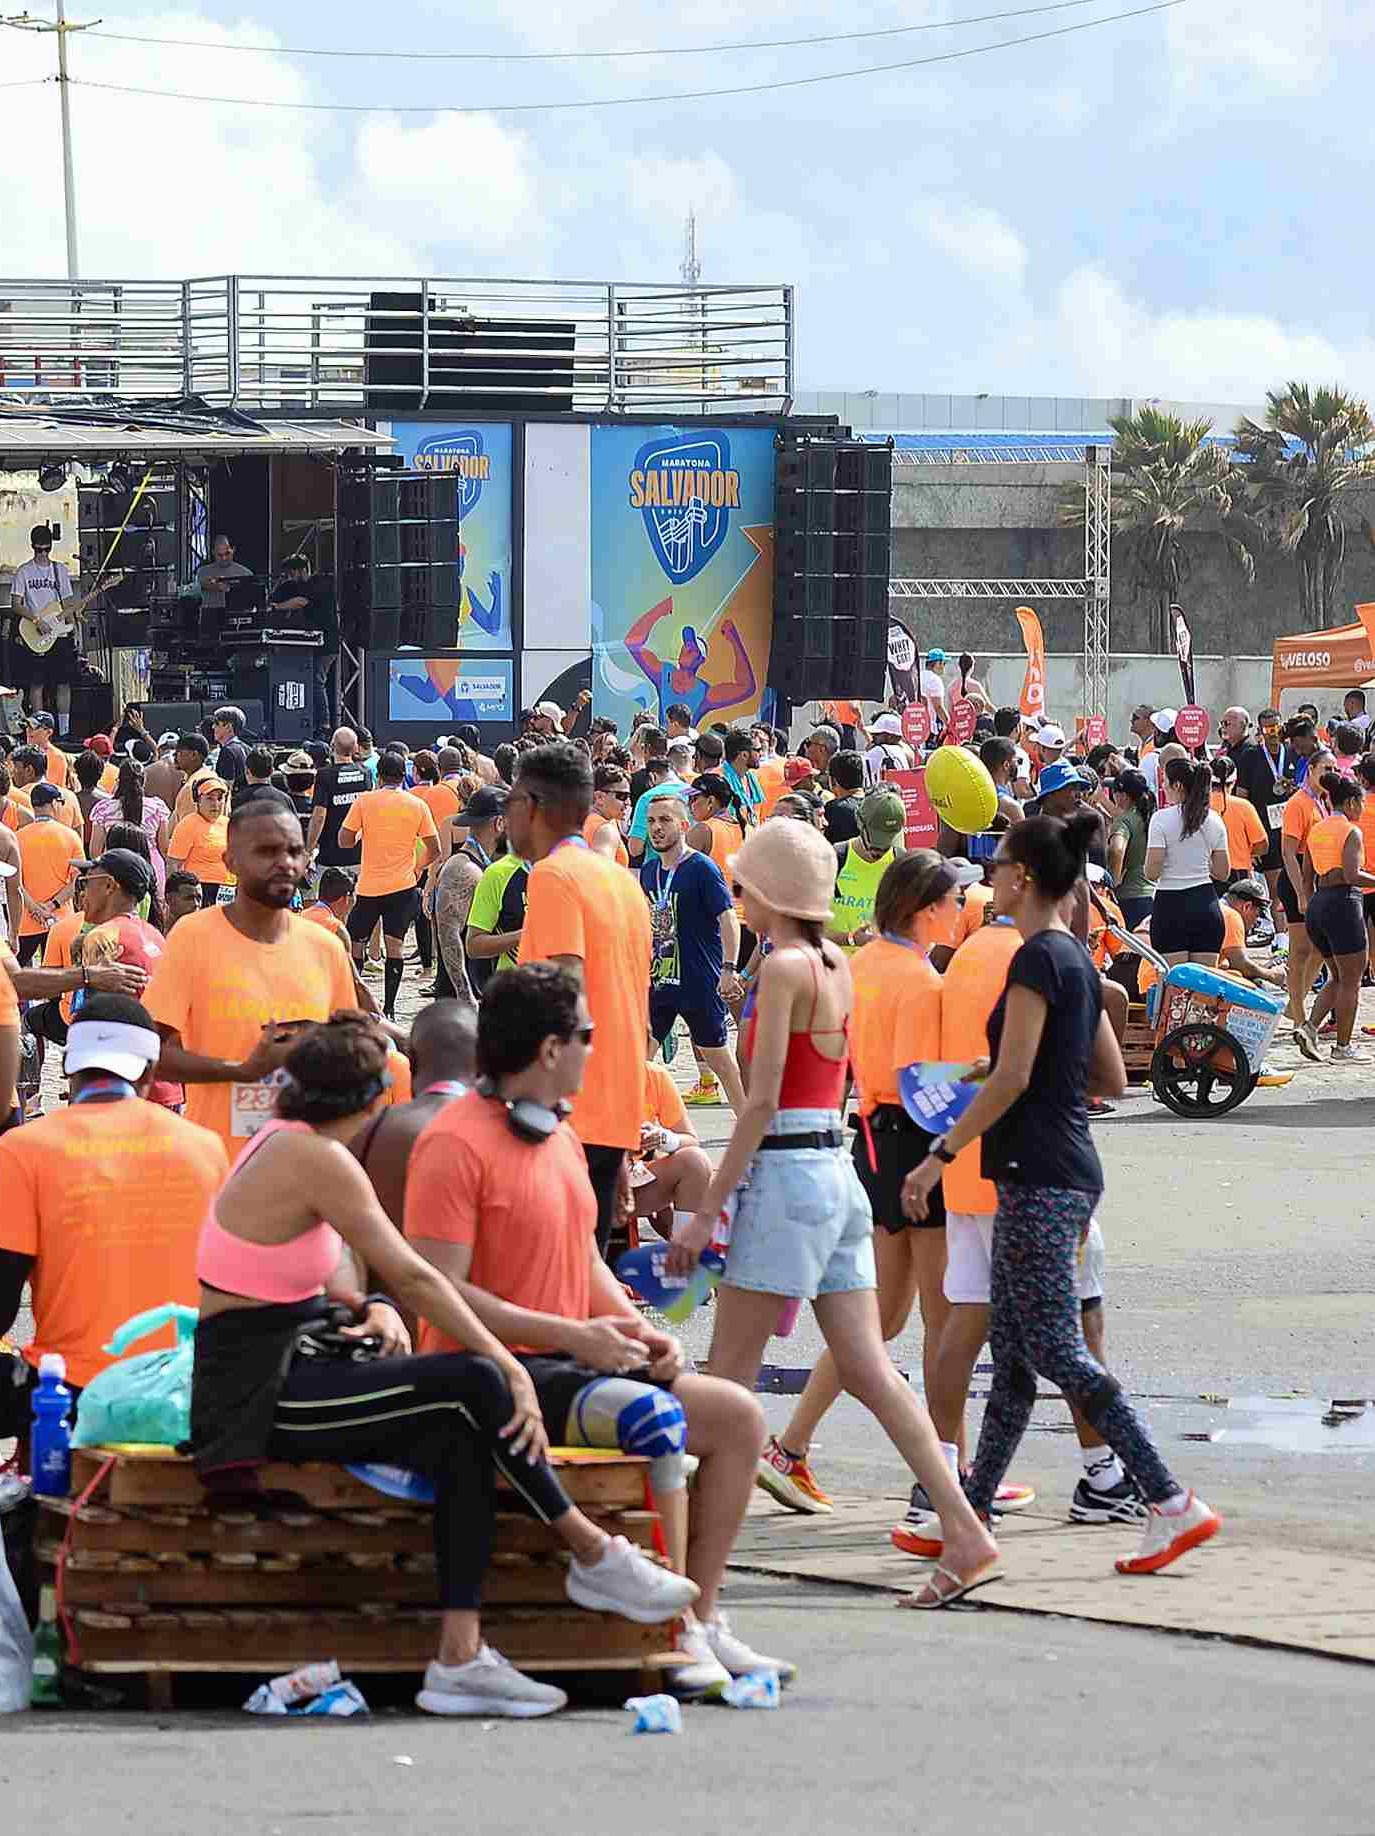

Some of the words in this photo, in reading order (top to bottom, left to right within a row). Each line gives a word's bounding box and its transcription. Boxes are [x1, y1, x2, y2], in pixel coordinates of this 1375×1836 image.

[661, 459, 711, 468] MARATONA
[629, 470, 739, 508] SALVADOR
[1288, 651, 1330, 667] VELOSO
